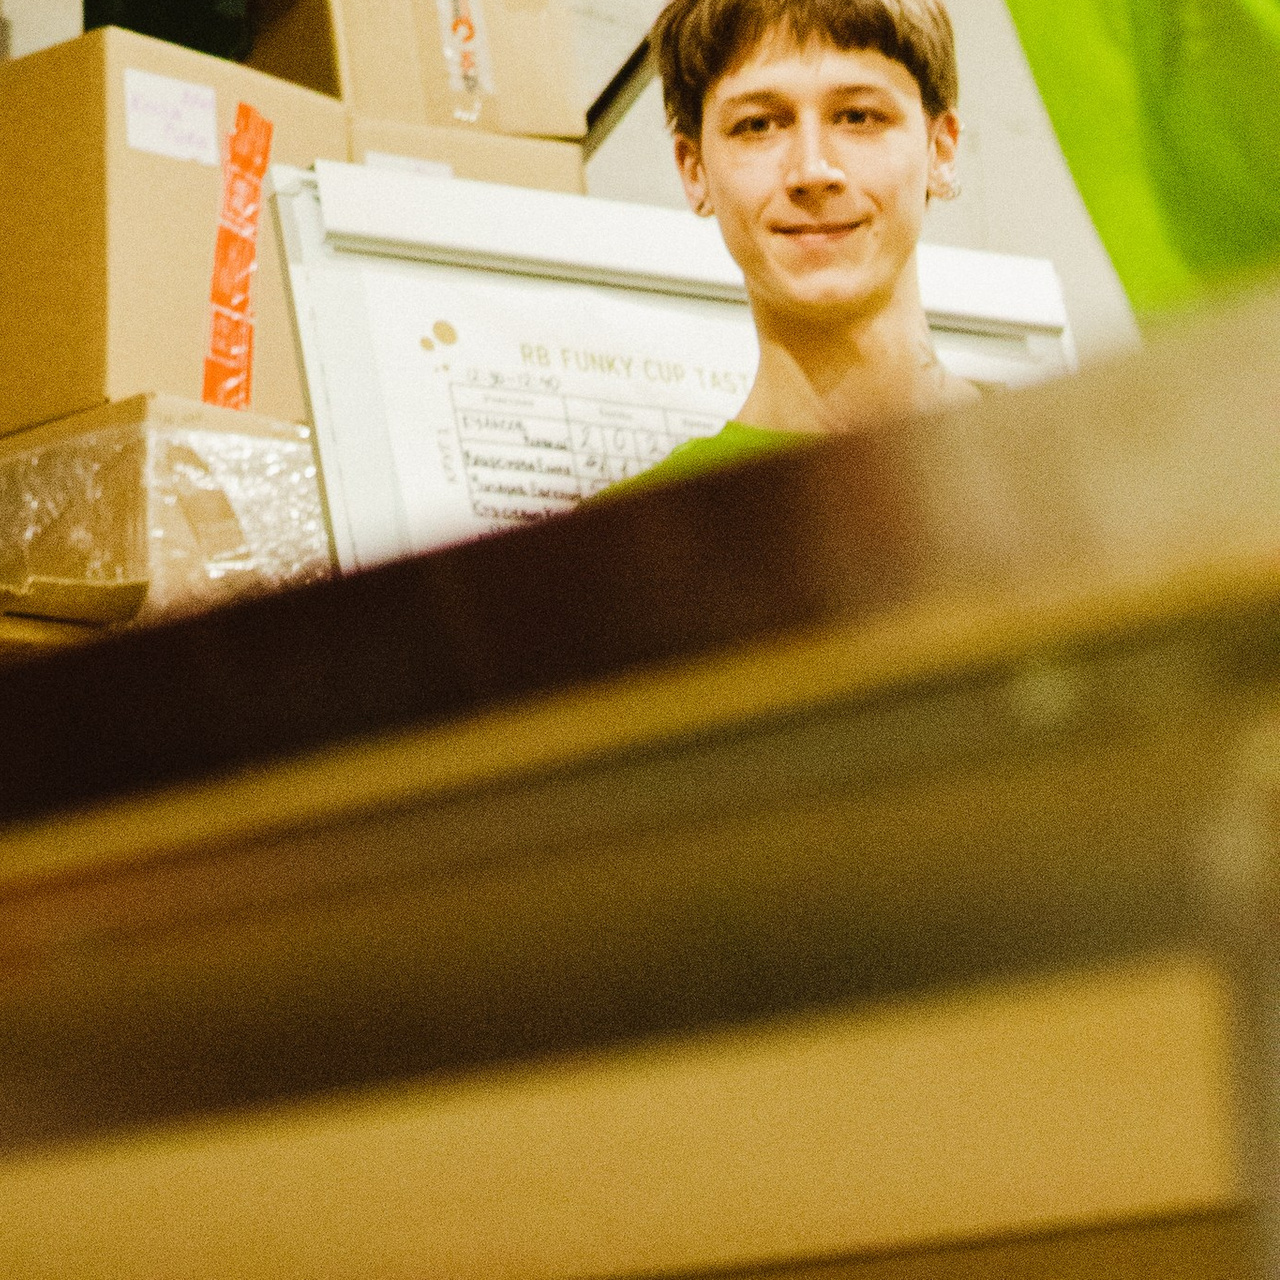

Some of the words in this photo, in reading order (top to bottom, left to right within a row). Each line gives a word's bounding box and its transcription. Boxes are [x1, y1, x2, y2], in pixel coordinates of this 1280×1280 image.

[519, 342, 551, 367] RB
[561, 346, 633, 378] FUNKY
[643, 355, 686, 383] CUP
